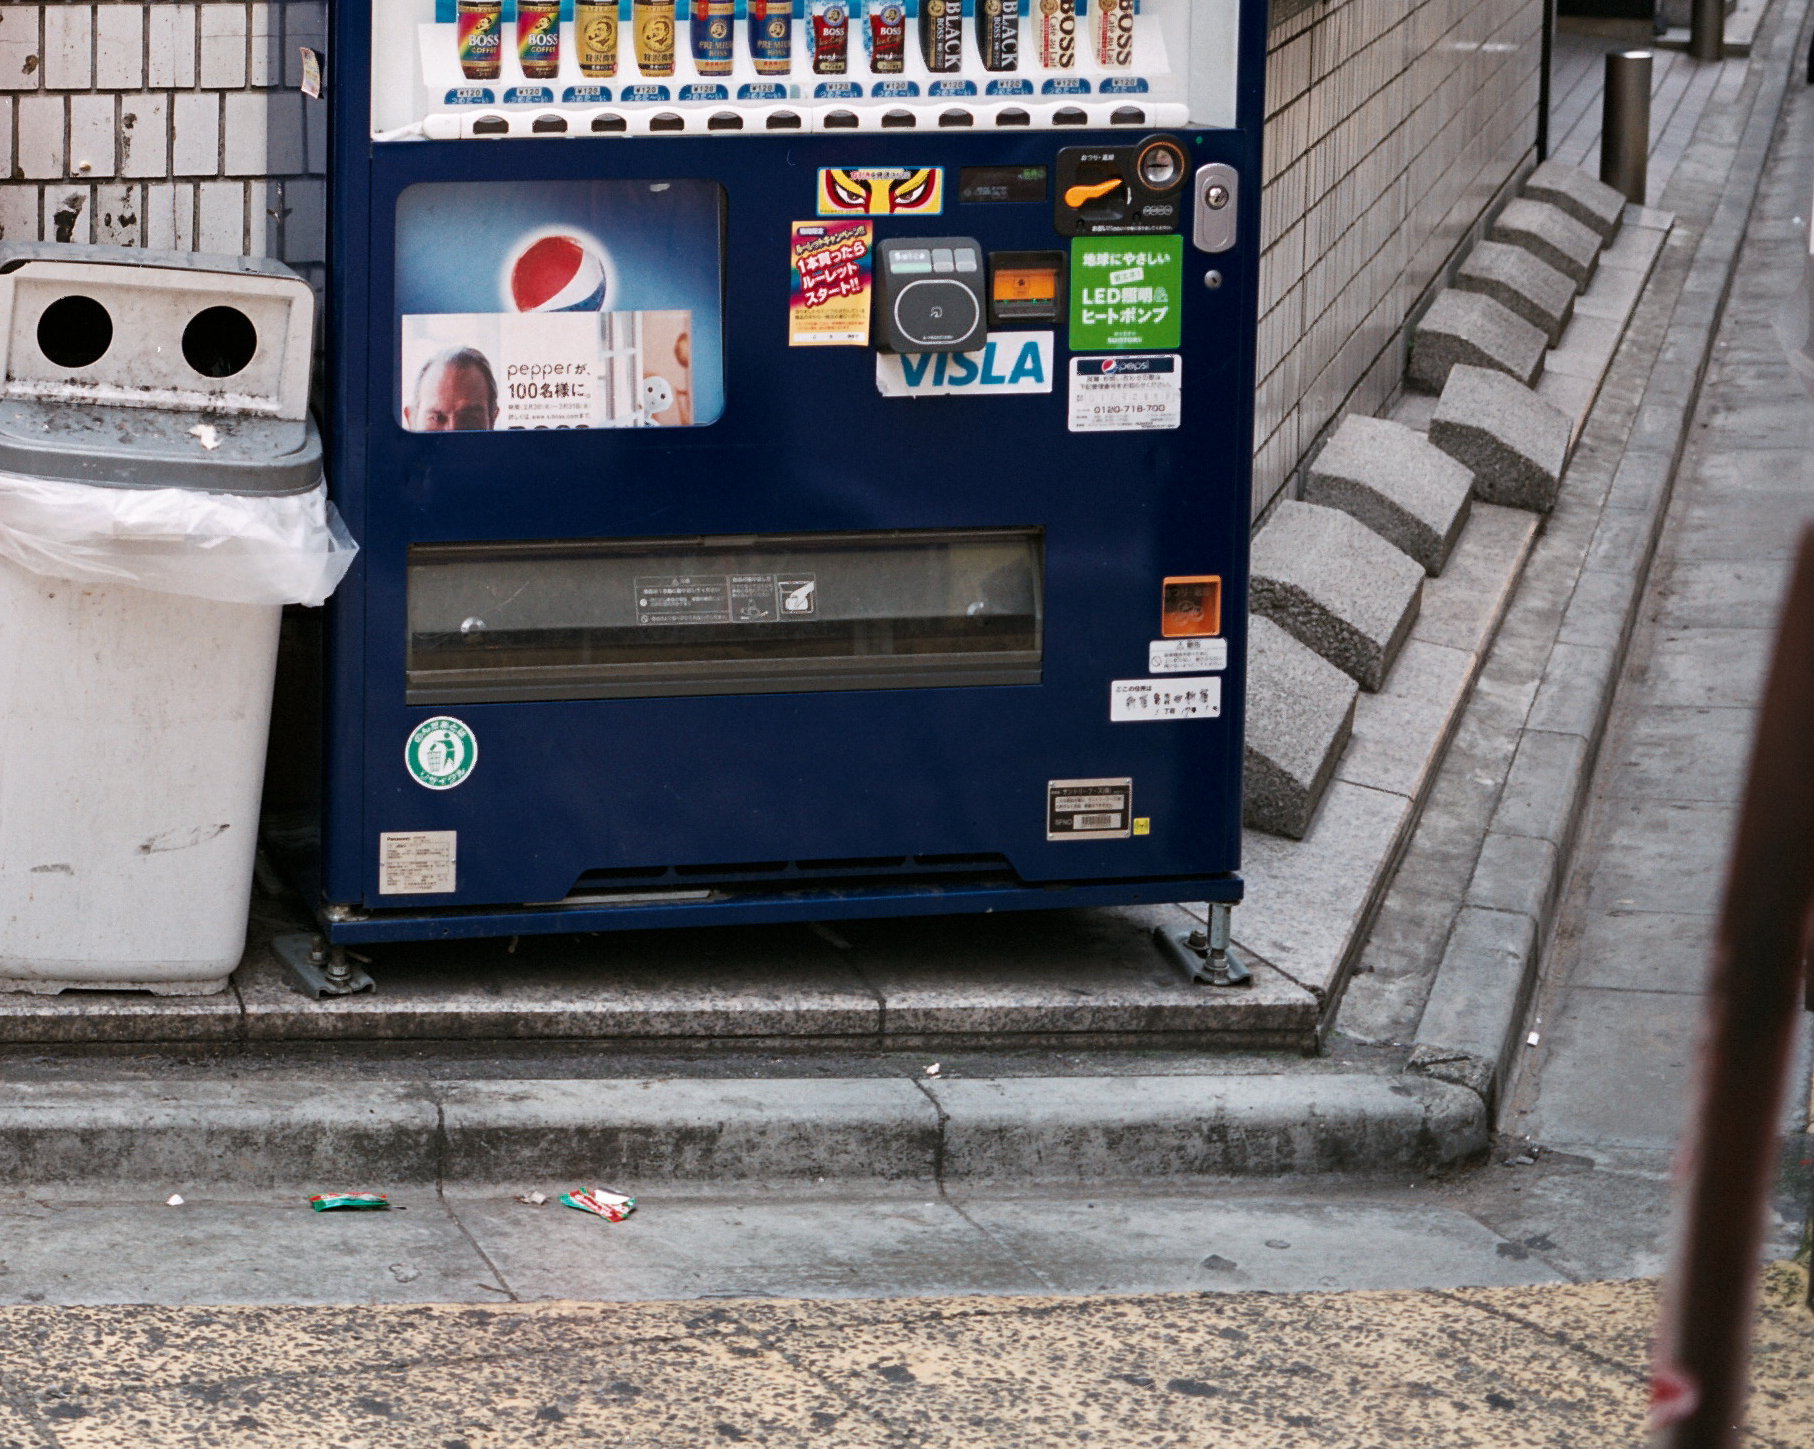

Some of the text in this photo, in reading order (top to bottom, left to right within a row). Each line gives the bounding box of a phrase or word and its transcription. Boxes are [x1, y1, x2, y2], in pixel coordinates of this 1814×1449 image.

[468, 34, 499, 46] BOSS
[527, 34, 558, 46] BOSS
[822, 27, 845, 36] BOSS
[880, 27, 902, 36] BOSS
[945, 1, 962, 69] BLACK
[1002, 0, 1018, 68] BLACK
[797, 240, 867, 274] 1本買ったら
[894, 251, 926, 261] Suica
[1082, 252, 1171, 267] 地球にやさしい
[803, 262, 859, 290] ルーレット
[805, 277, 860, 306] スタート!!
[1082, 306, 1169, 325] ヒートポンプ
[507, 363, 591, 381] pepperが、
[508, 382, 591, 399] 100名様に。
[1093, 404, 1166, 414] 0120-718-700
[413, 719, 467, 744] のんだあとは
[419, 766, 466, 786] リサイクル
